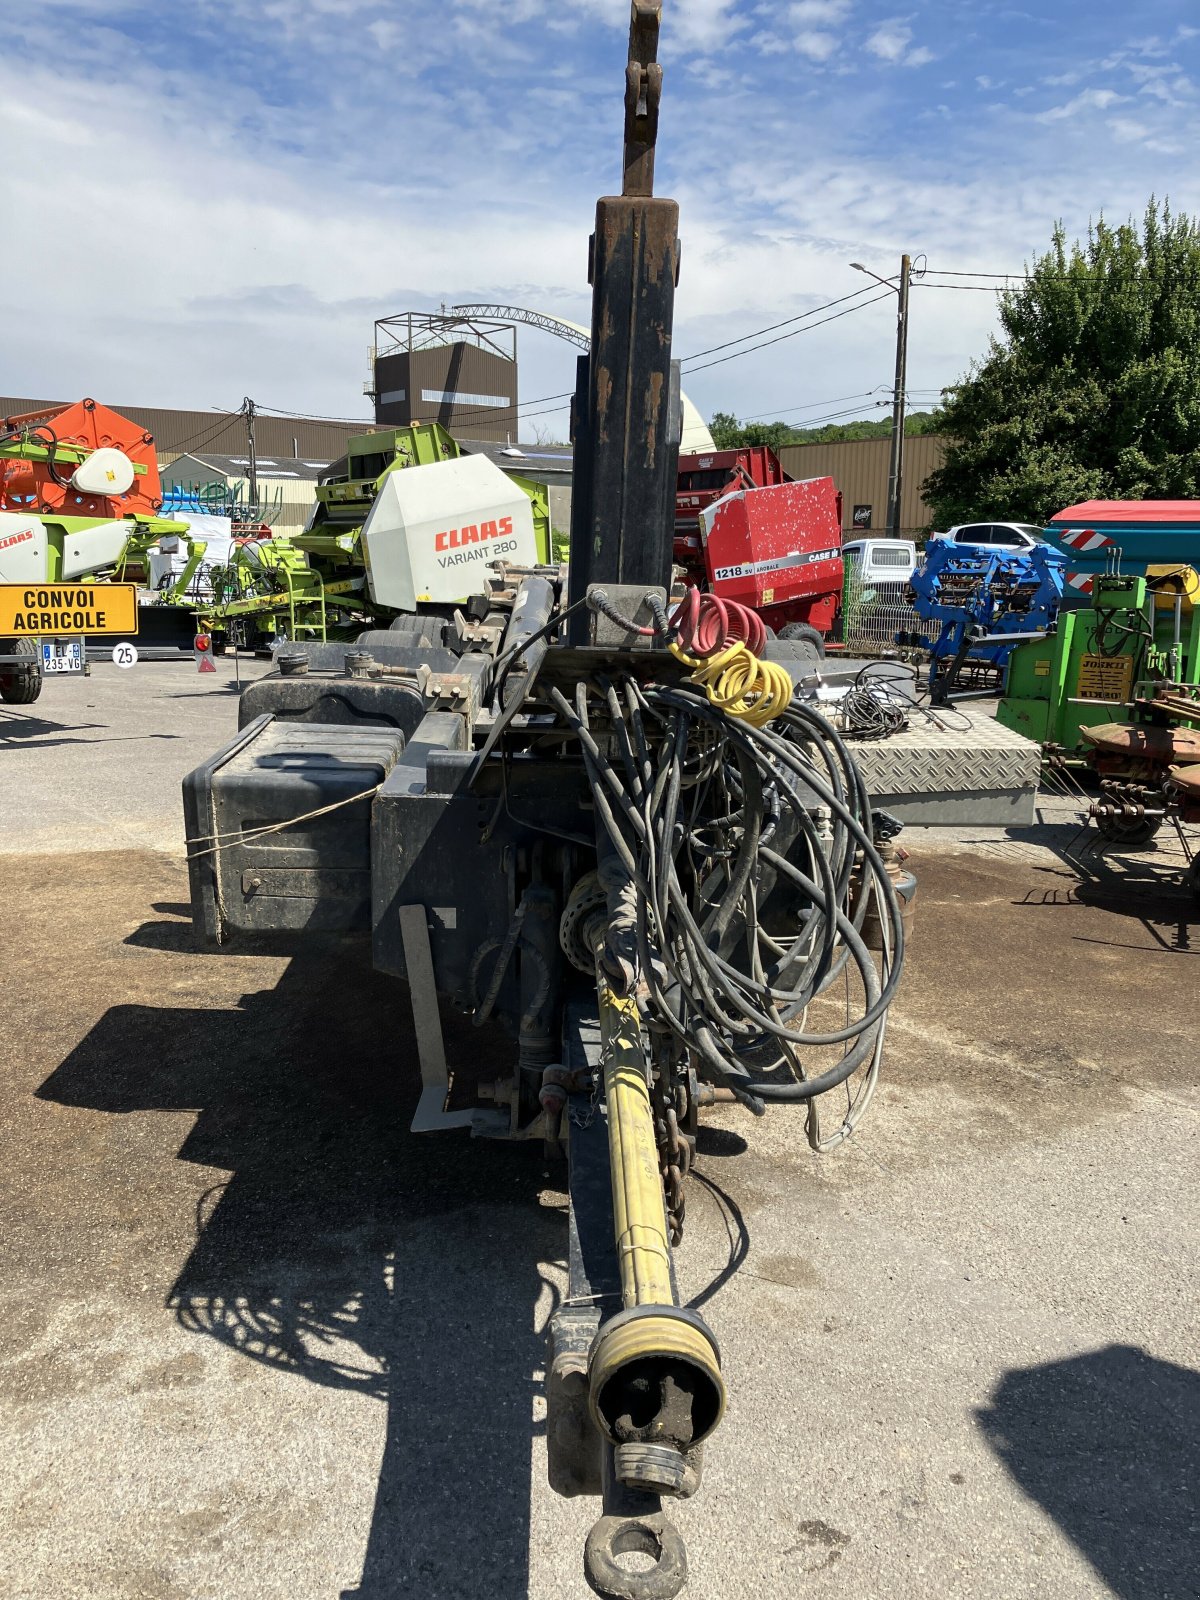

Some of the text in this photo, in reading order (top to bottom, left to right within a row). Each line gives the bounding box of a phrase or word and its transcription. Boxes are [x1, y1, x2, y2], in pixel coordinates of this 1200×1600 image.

[435, 516, 513, 552] CLAAS
[437, 540, 518, 569] VARIANT 280
[808, 552, 830, 563] CASE
[715, 567, 742, 579] 1218
[23, 590, 95, 609] CONVOI
[13, 611, 107, 631] AGRICOLE
[45, 658, 80, 670] 235-VG
[117, 648, 133, 664] 25
